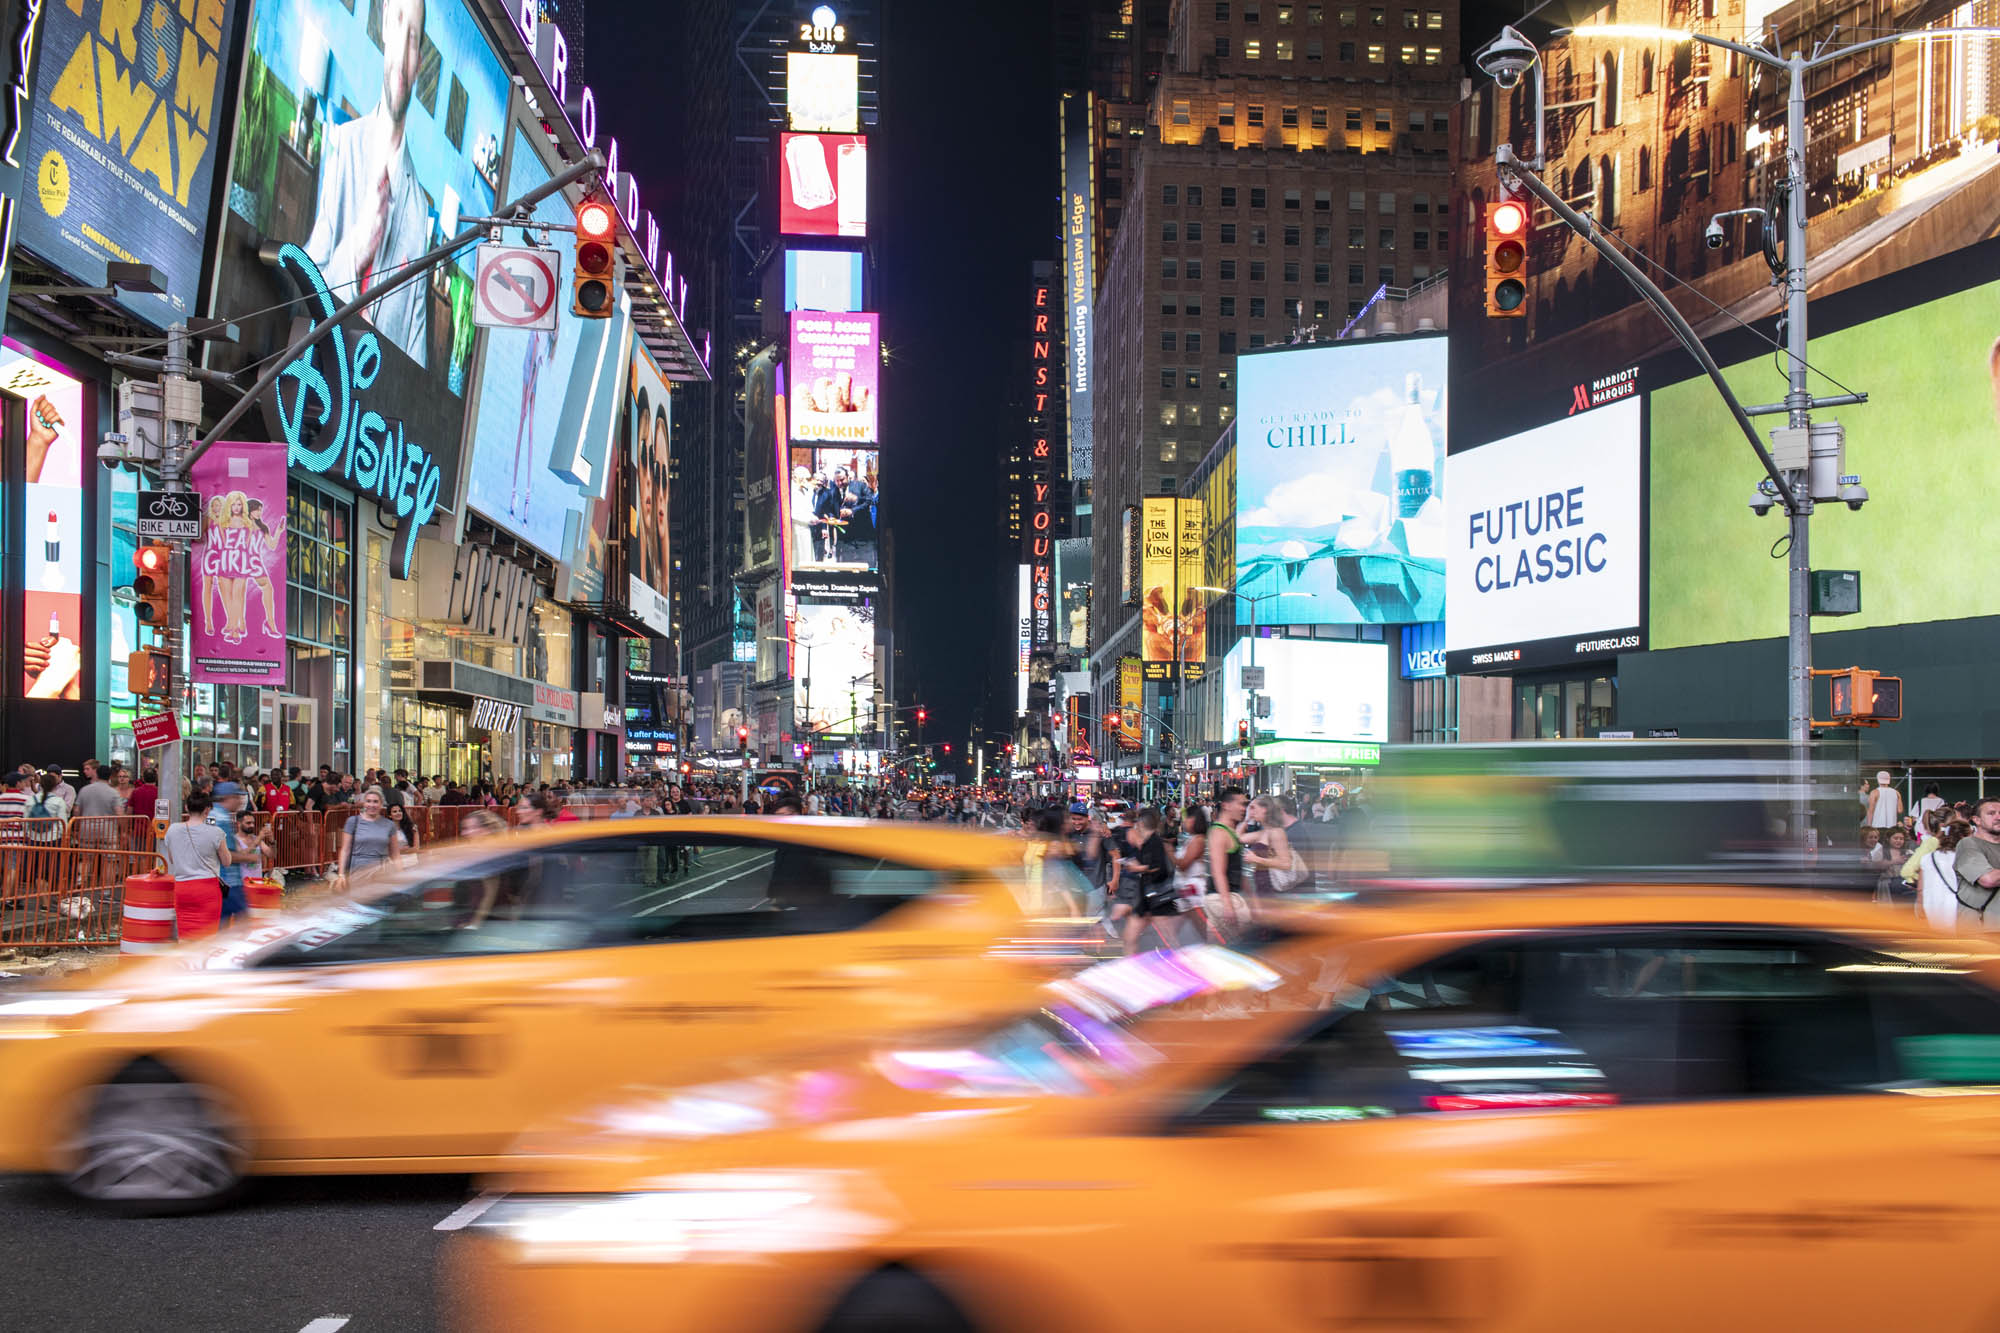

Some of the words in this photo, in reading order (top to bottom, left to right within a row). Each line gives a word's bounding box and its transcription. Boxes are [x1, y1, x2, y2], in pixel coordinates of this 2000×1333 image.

[800, 24, 846, 42] 2018
[50, 31, 208, 208] AWAY
[46, 113, 61, 132] THE
[61, 124, 107, 167] REMARKABLE
[107, 159, 123, 180] TRUE
[123, 173, 144, 194] STORY
[144, 187, 159, 207] NOW
[159, 200, 168, 214] ON
[167, 204, 198, 236] BROADWAY
[1071, 195, 1086, 236] Edge
[1072, 238, 1085, 304] Westlaw
[1034, 288, 1050, 412] ERNST
[1074, 304, 1088, 393] Introducing
[1592, 366, 1639, 391] MARRIOTT
[1592, 381, 1634, 404] MARQUIS
[800, 424, 870, 438] DUNKIN'
[1266, 423, 1356, 449] CHILL
[1034, 438, 1050, 457] &
[1398, 487, 1431, 496] MATUA
[140, 520, 164, 533] BIKE
[169, 521, 197, 534] LANE
[1469, 485, 1584, 549] FUTURE
[207, 526, 264, 551] MEAN
[1033, 483, 1049, 610] YOUNG
[1147, 528, 1169, 542] LION
[204, 549, 266, 577] GIRLS
[1145, 543, 1172, 559] KING
[1475, 532, 1608, 593] CLASSIC
[1021, 618, 1030, 638] BIG
[1020, 640, 1031, 672] THINK
[1472, 653, 1493, 665] SWISS
[1493, 650, 1514, 662] MADE
[133, 721, 142, 729] NO
[142, 716, 168, 727] STANDING
[473, 698, 512, 732] FOREVER
[509, 705, 523, 733] 21
[136, 726, 158, 735] Anytime
[634, 730, 652, 738] after
